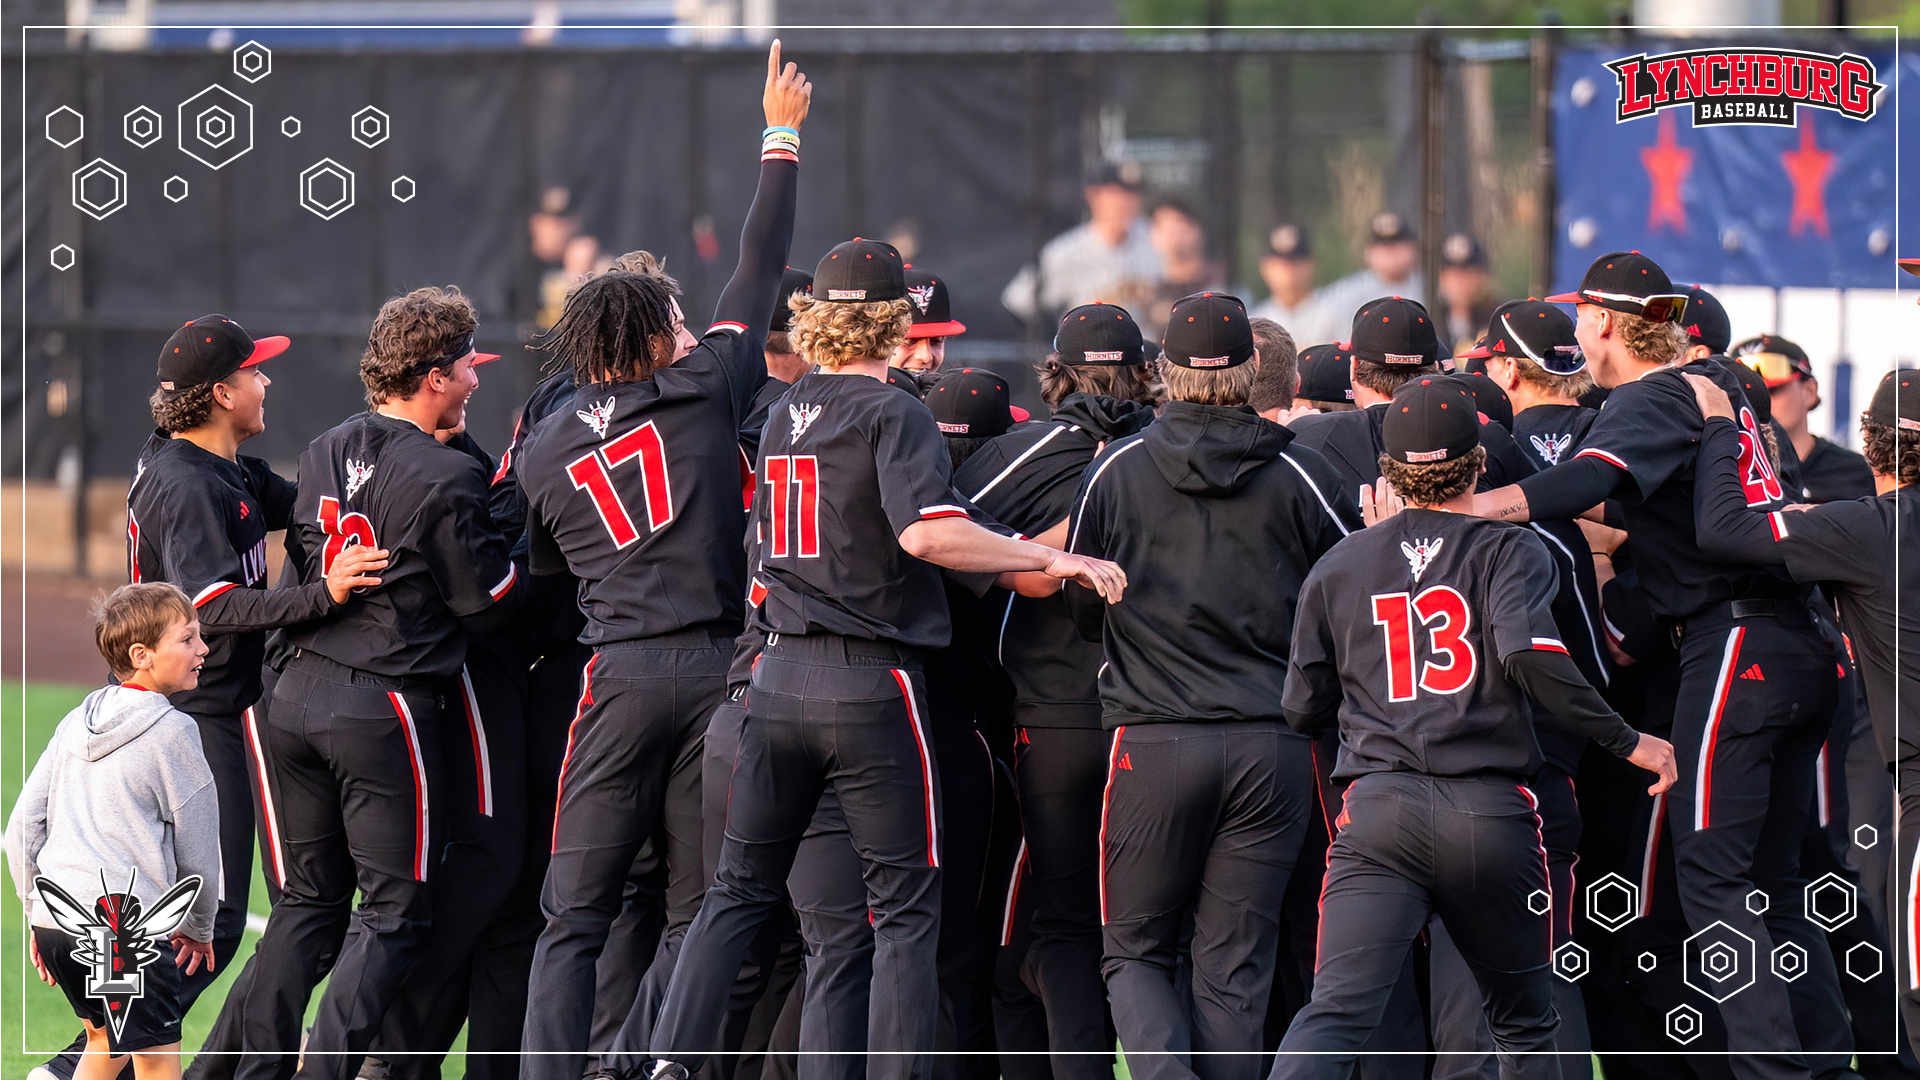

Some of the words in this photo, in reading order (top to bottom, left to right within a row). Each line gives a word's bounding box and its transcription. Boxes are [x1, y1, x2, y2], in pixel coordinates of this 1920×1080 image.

[1085, 351, 1122, 361] HORNETS
[1189, 356, 1229, 367] HORNETS
[1384, 354, 1422, 364] HORNETS
[565, 419, 673, 551] 17
[764, 454, 820, 558] 11
[1370, 585, 1477, 703] 13
